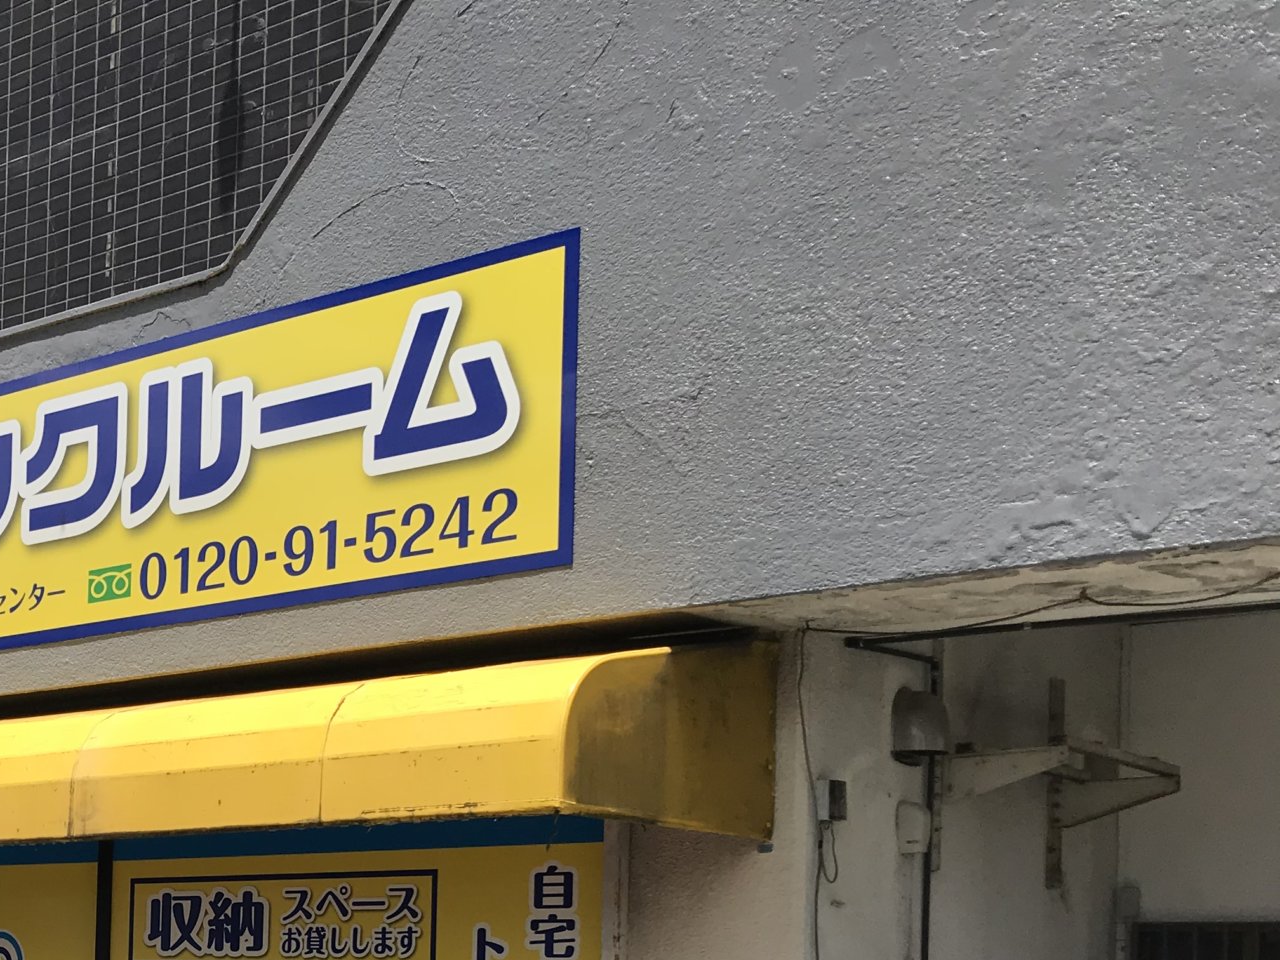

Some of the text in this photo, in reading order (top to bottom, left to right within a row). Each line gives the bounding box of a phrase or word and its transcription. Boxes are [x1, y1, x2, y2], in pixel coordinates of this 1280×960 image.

[139, 488, 519, 600] 0120-91-5242
[147, 890, 266, 953] 収納
[281, 887, 422, 922] スペース
[281, 927, 420, 958] お貸しします
